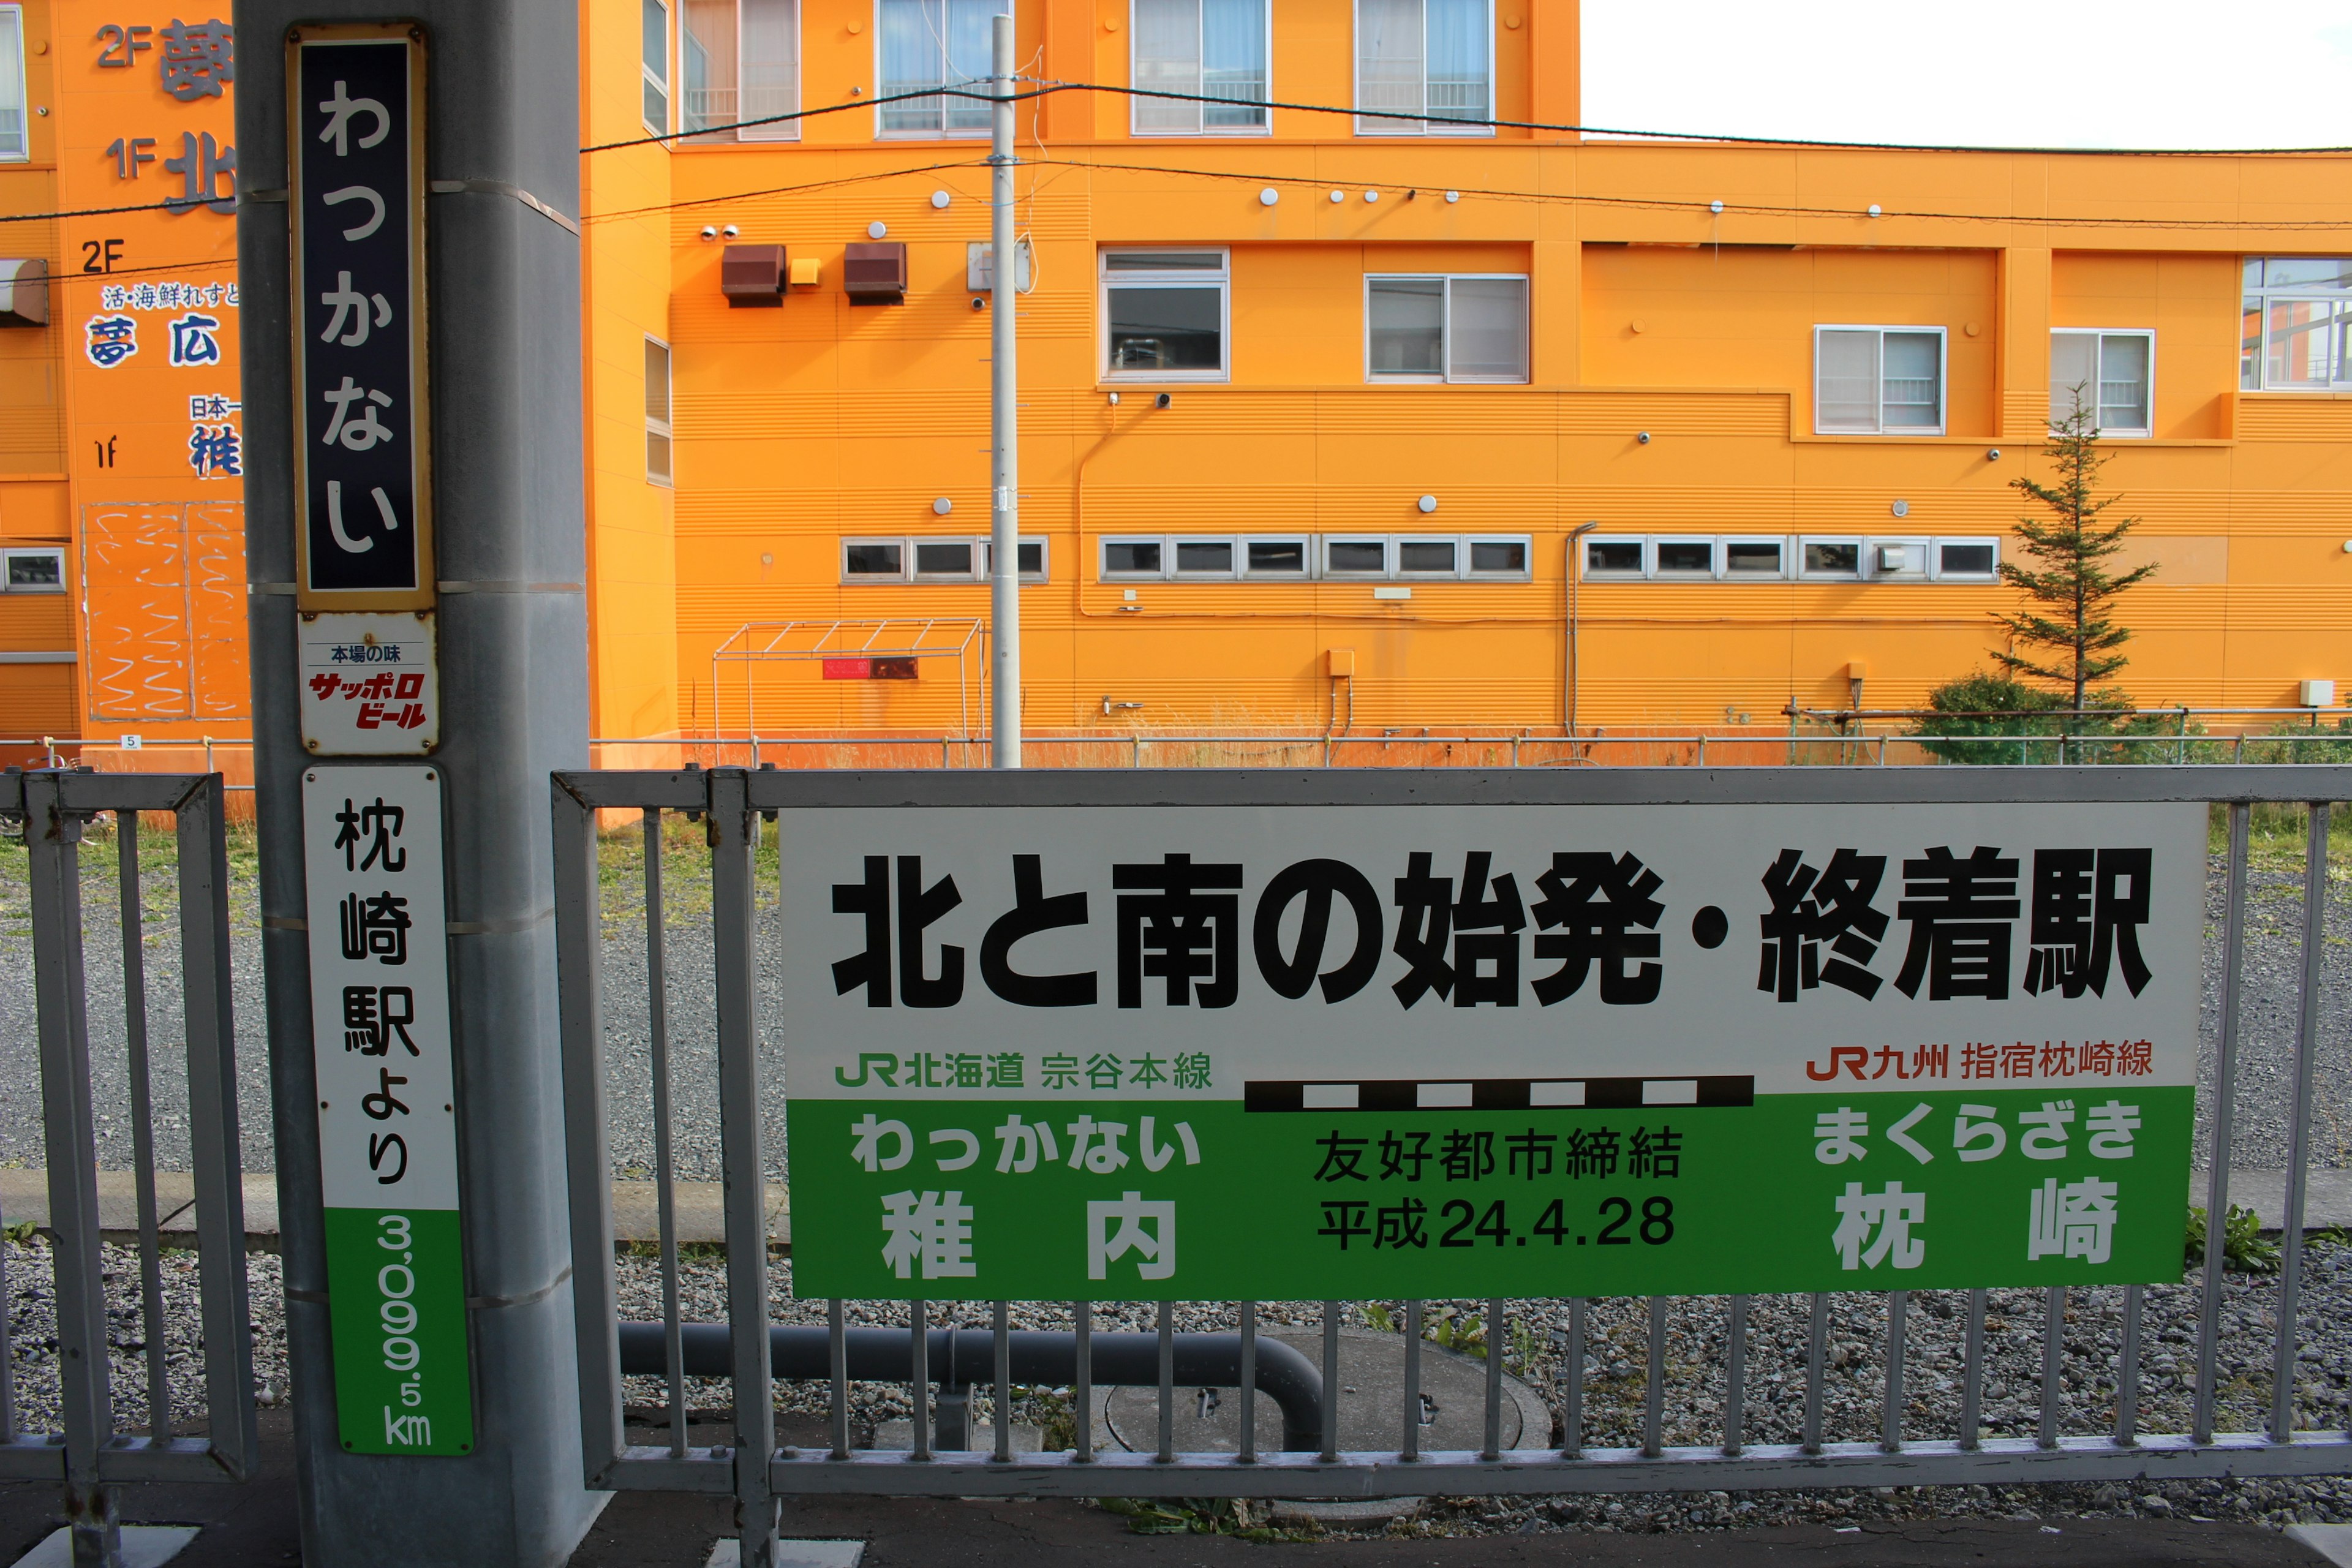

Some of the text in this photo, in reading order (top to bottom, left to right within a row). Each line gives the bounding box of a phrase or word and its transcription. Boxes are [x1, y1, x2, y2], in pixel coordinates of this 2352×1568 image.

[97, 24, 153, 67] 2F
[107, 138, 157, 178] 1F
[82, 239, 124, 273] 2F
[331, 644, 401, 663] 本場の味
[309, 671, 425, 701] サッポロ
[356, 703, 426, 729] ビール
[127, 736, 135, 746] 5
[831, 845, 2153, 1011] 北と南の始発・終着駅
[334, 797, 420, 1185] 枕崎駅より
[835, 1051, 1213, 1090] JR北海道 宗谷本線
[1806, 1039, 2154, 1082] JR九州 指宿枕崎線
[850, 1114, 1201, 1175] わっかない
[1814, 1099, 2141, 1165] まくらざき
[1313, 1125, 1683, 1183] 友好都市締結
